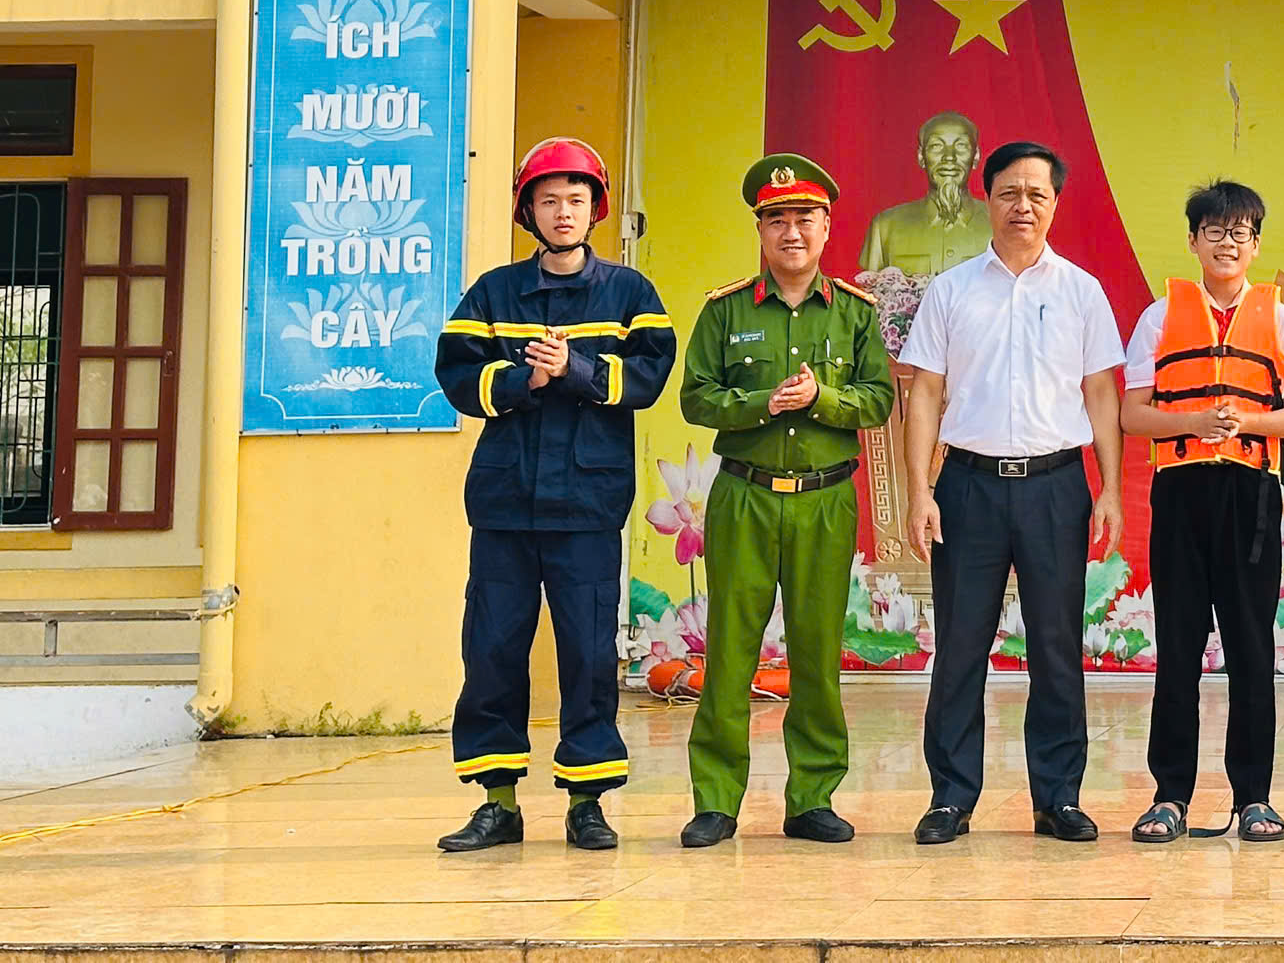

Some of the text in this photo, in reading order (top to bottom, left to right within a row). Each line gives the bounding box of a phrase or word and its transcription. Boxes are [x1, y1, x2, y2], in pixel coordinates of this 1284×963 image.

[326, 14, 400, 59] ÍCH
[302, 84, 421, 131] MƯỜI
[306, 158, 412, 203] NĂM
[280, 227, 432, 276] TRỒNG
[310, 302, 400, 348] CÂY
